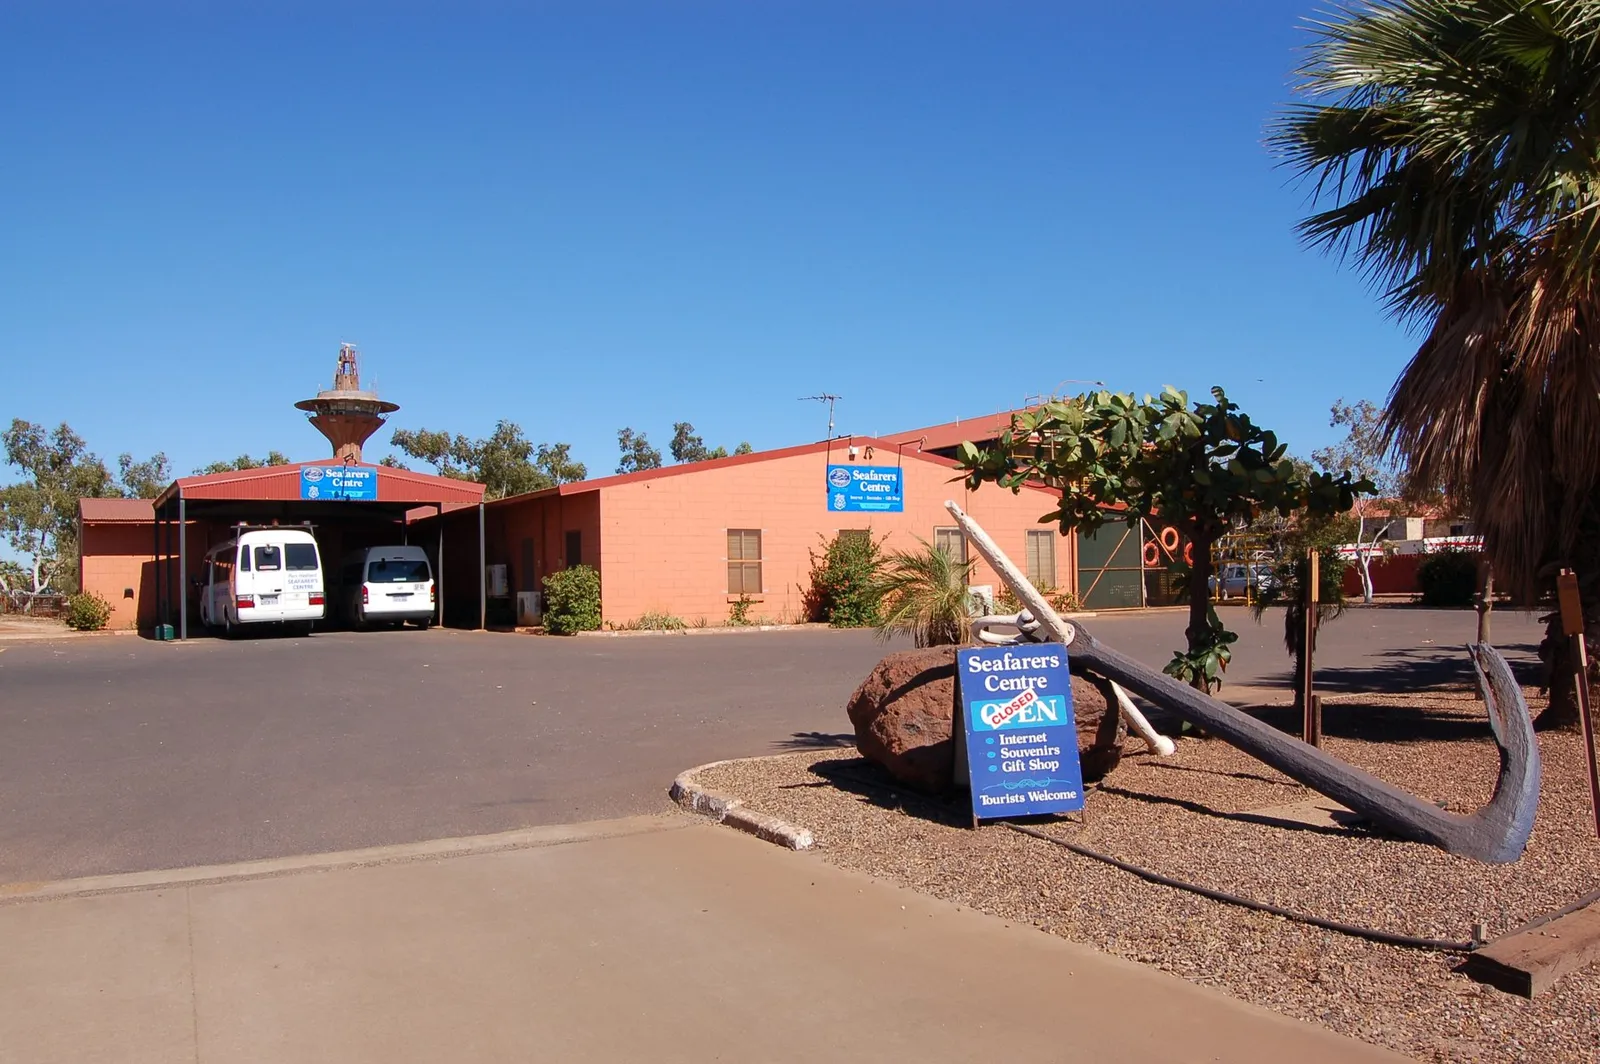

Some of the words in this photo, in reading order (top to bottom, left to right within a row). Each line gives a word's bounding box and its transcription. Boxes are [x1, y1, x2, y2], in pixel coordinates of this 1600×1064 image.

[853, 470, 897, 481] Seafarers
[860, 481, 890, 492] Centre
[968, 653, 1060, 673] Seafarers
[984, 674, 1048, 691] Centre
[991, 692, 1033, 725] CLOSED
[999, 732, 1047, 745] Internet
[1000, 745, 1060, 759] Souvenirs
[1002, 759, 1026, 772] Gift
[1029, 758, 1059, 772] Shop
[979, 791, 1025, 806] Tourists
[1028, 789, 1077, 802] Welcome
